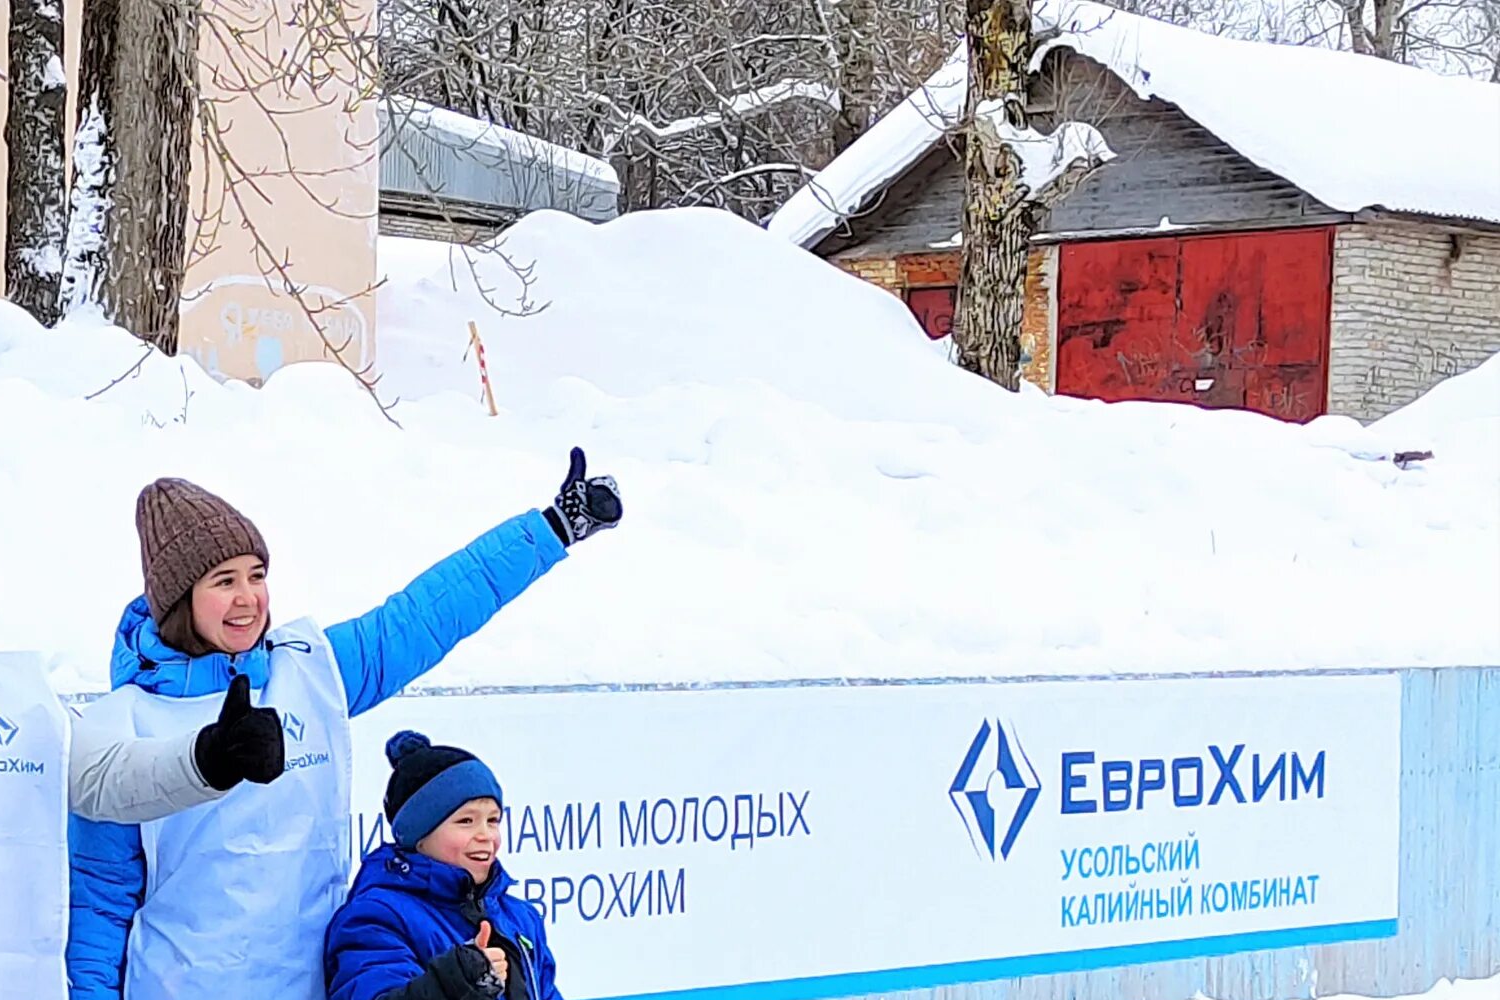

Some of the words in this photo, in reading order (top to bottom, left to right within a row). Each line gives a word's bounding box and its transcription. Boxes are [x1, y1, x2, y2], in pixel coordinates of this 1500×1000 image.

[619, 790, 811, 850] МОЛОДЫХ
[1060, 831, 1200, 881] УСОЛЬСКИЙ
[512, 867, 686, 924] ВРОХИМ
[1061, 876, 1193, 928] КАЛИЙНЫЙ
[1200, 874, 1320, 915] КОМБИНАТ
